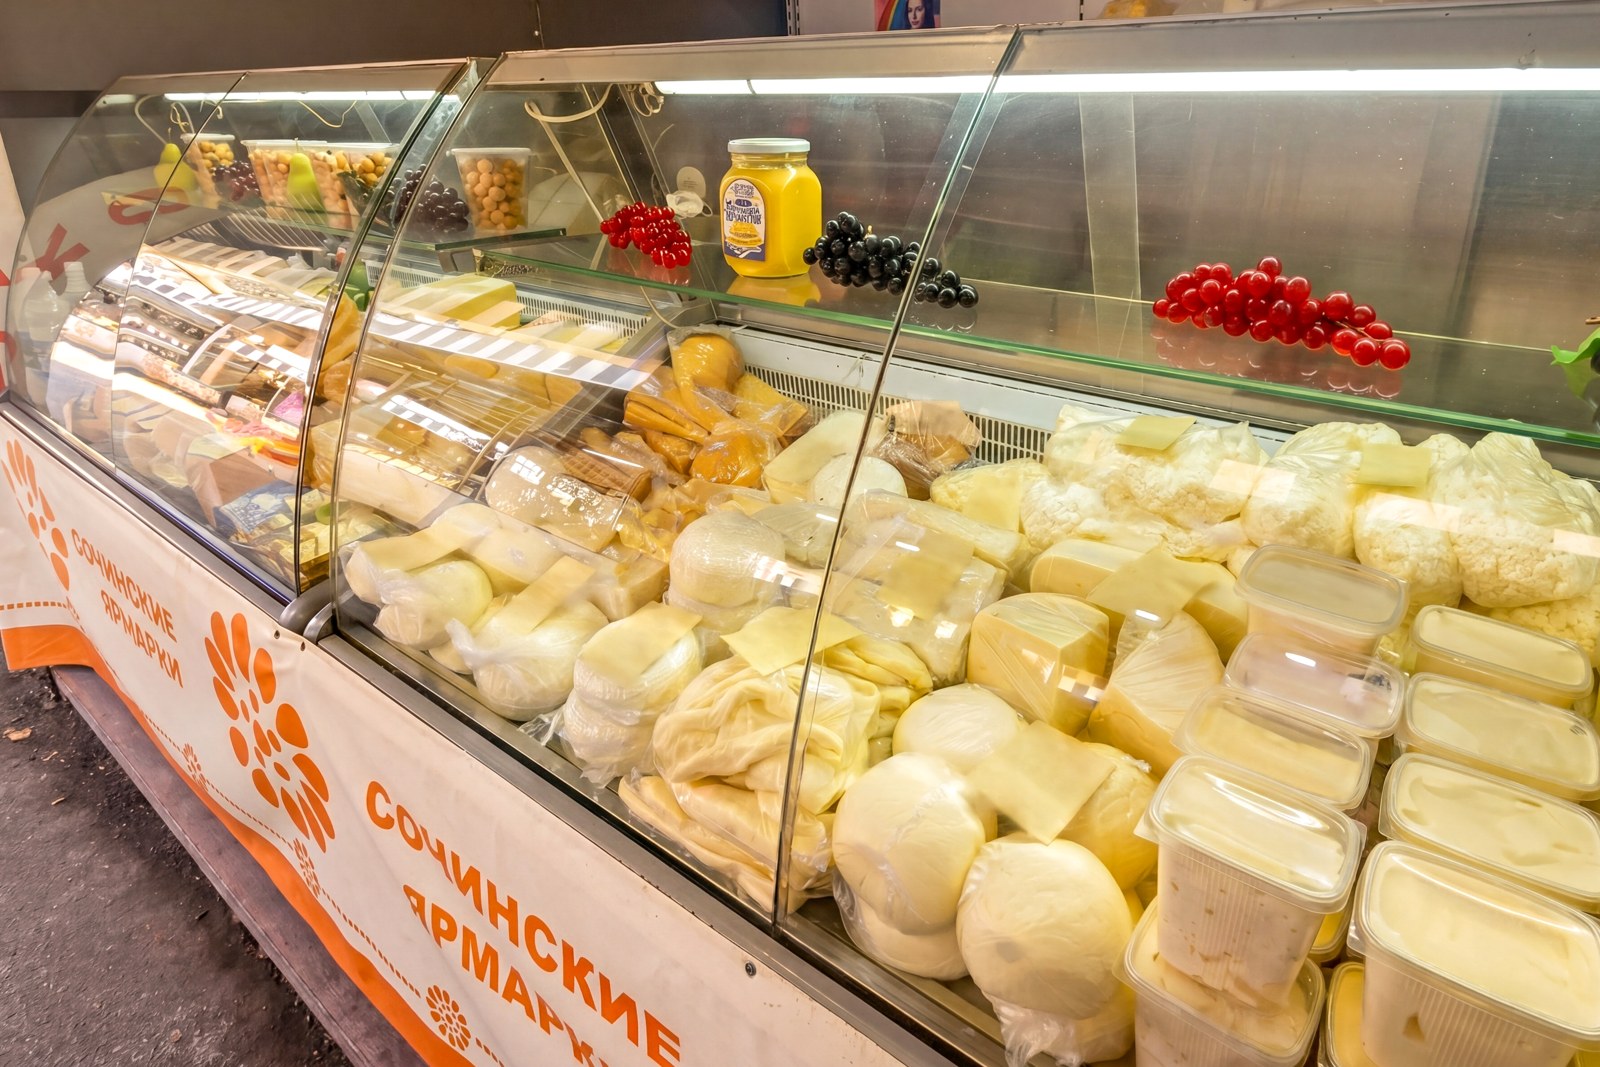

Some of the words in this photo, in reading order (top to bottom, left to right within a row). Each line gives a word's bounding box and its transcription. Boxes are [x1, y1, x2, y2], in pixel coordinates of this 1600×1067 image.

[71, 528, 177, 643] СОЧИНСКИЕ
[100, 589, 184, 689] ЯРМАРКИ
[365, 780, 681, 1067] СОЧИНСКИЕ
[402, 884, 609, 1067] ЯРМАРК
